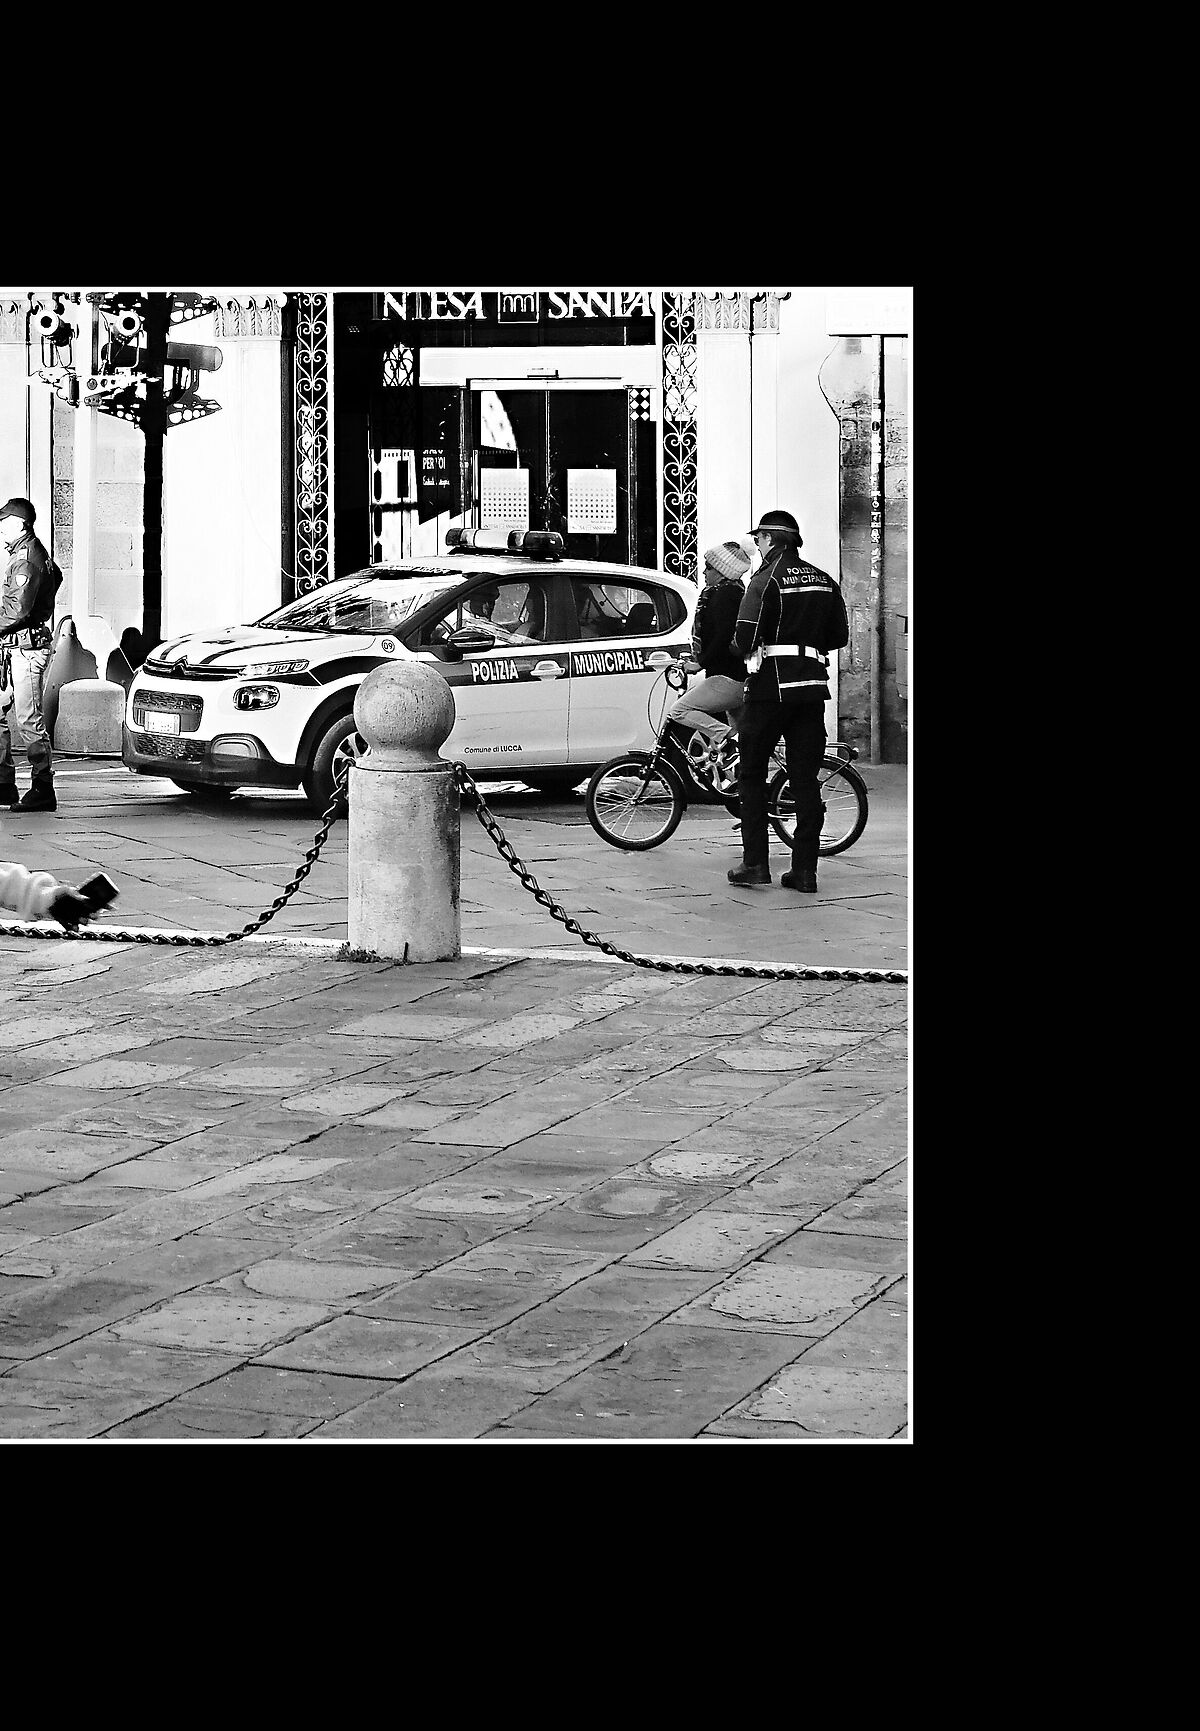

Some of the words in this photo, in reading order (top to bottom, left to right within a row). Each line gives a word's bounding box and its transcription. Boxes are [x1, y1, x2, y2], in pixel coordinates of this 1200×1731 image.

[471, 659, 519, 683] POLIZIA
[573, 650, 645, 675] MUNICIPALE
[464, 746, 492, 754] Comune
[492, 745, 500, 753] di
[500, 744, 523, 752] LUCCA
